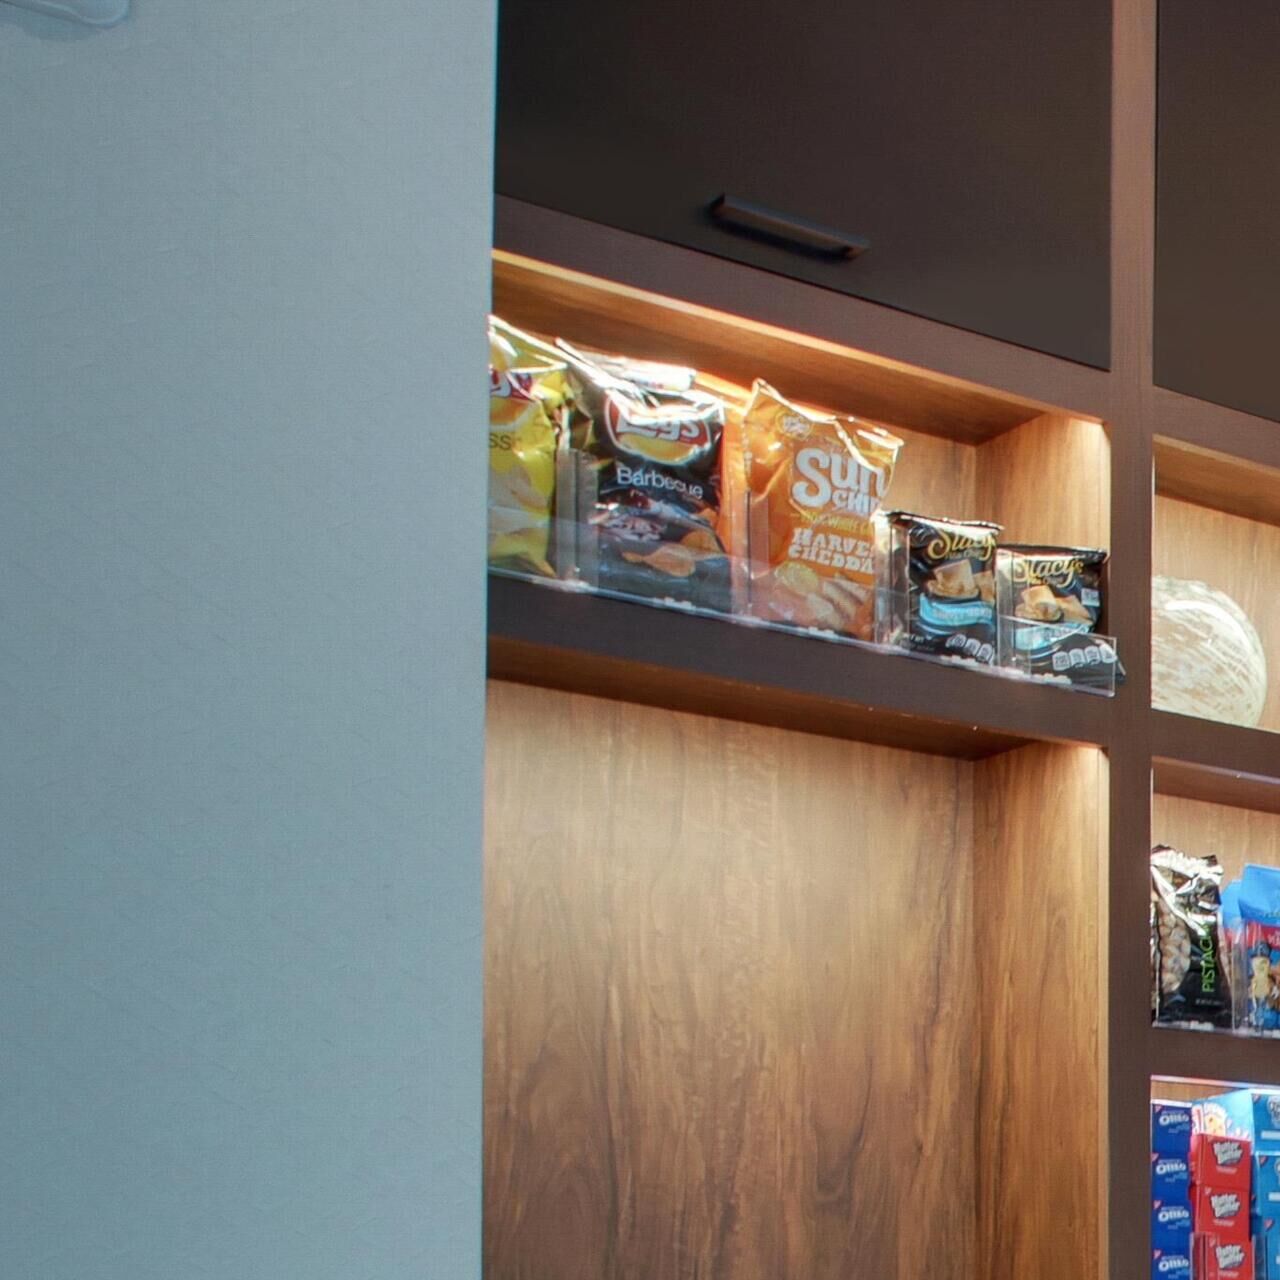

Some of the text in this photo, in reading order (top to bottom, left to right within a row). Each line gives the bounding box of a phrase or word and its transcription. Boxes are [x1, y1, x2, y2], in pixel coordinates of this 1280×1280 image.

[616, 466, 704, 501] Barbecue
[792, 527, 876, 558] HARVE
[1159, 1113, 1190, 1126] OREO
[1156, 1162, 1187, 1175] OREO
[1158, 1209, 1190, 1222] OREO
[1158, 1258, 1189, 1272] OREO
